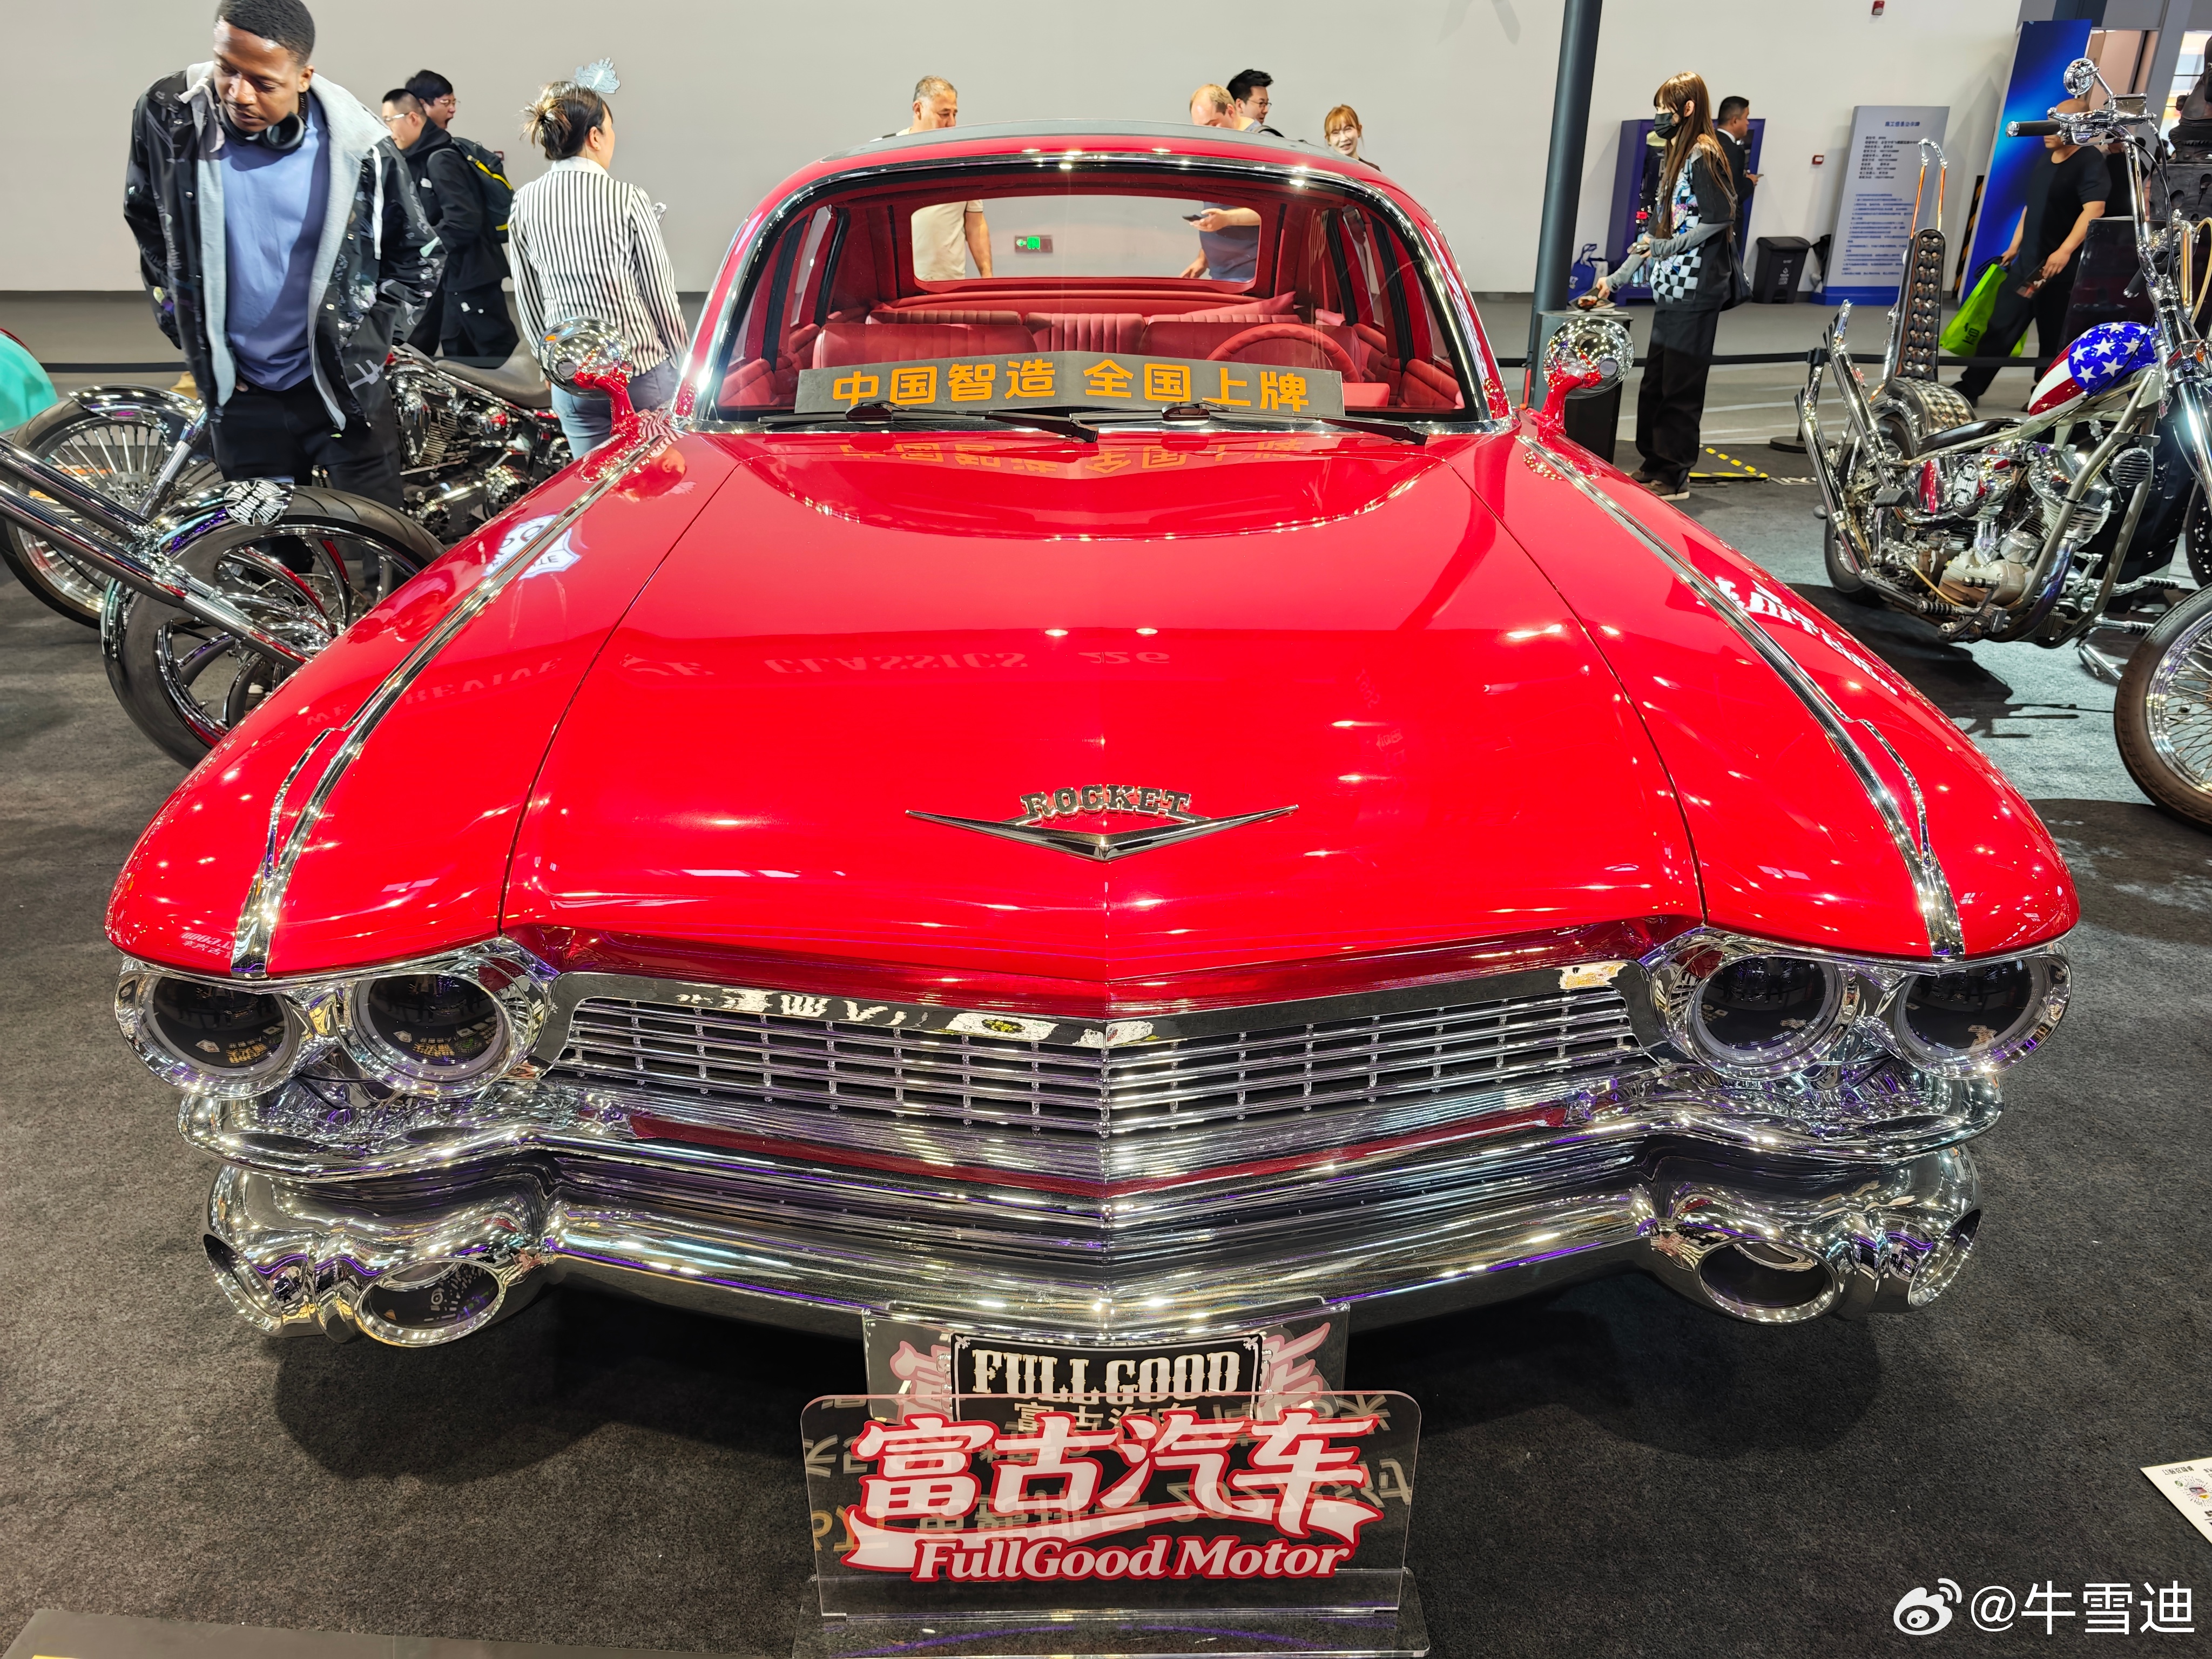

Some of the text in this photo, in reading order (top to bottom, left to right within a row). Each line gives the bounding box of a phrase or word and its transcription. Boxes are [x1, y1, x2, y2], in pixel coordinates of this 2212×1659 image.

[832, 359, 1310, 412] 中国智造 全国上牌
[228, 480, 280, 524] SONGSAN
[1021, 784, 1191, 819] ROCKET
[972, 1349, 1241, 1406] FULLGOOD
[853, 1411, 1376, 1537] 富古汽车
[913, 1537, 1353, 1580] FullGood Motor
